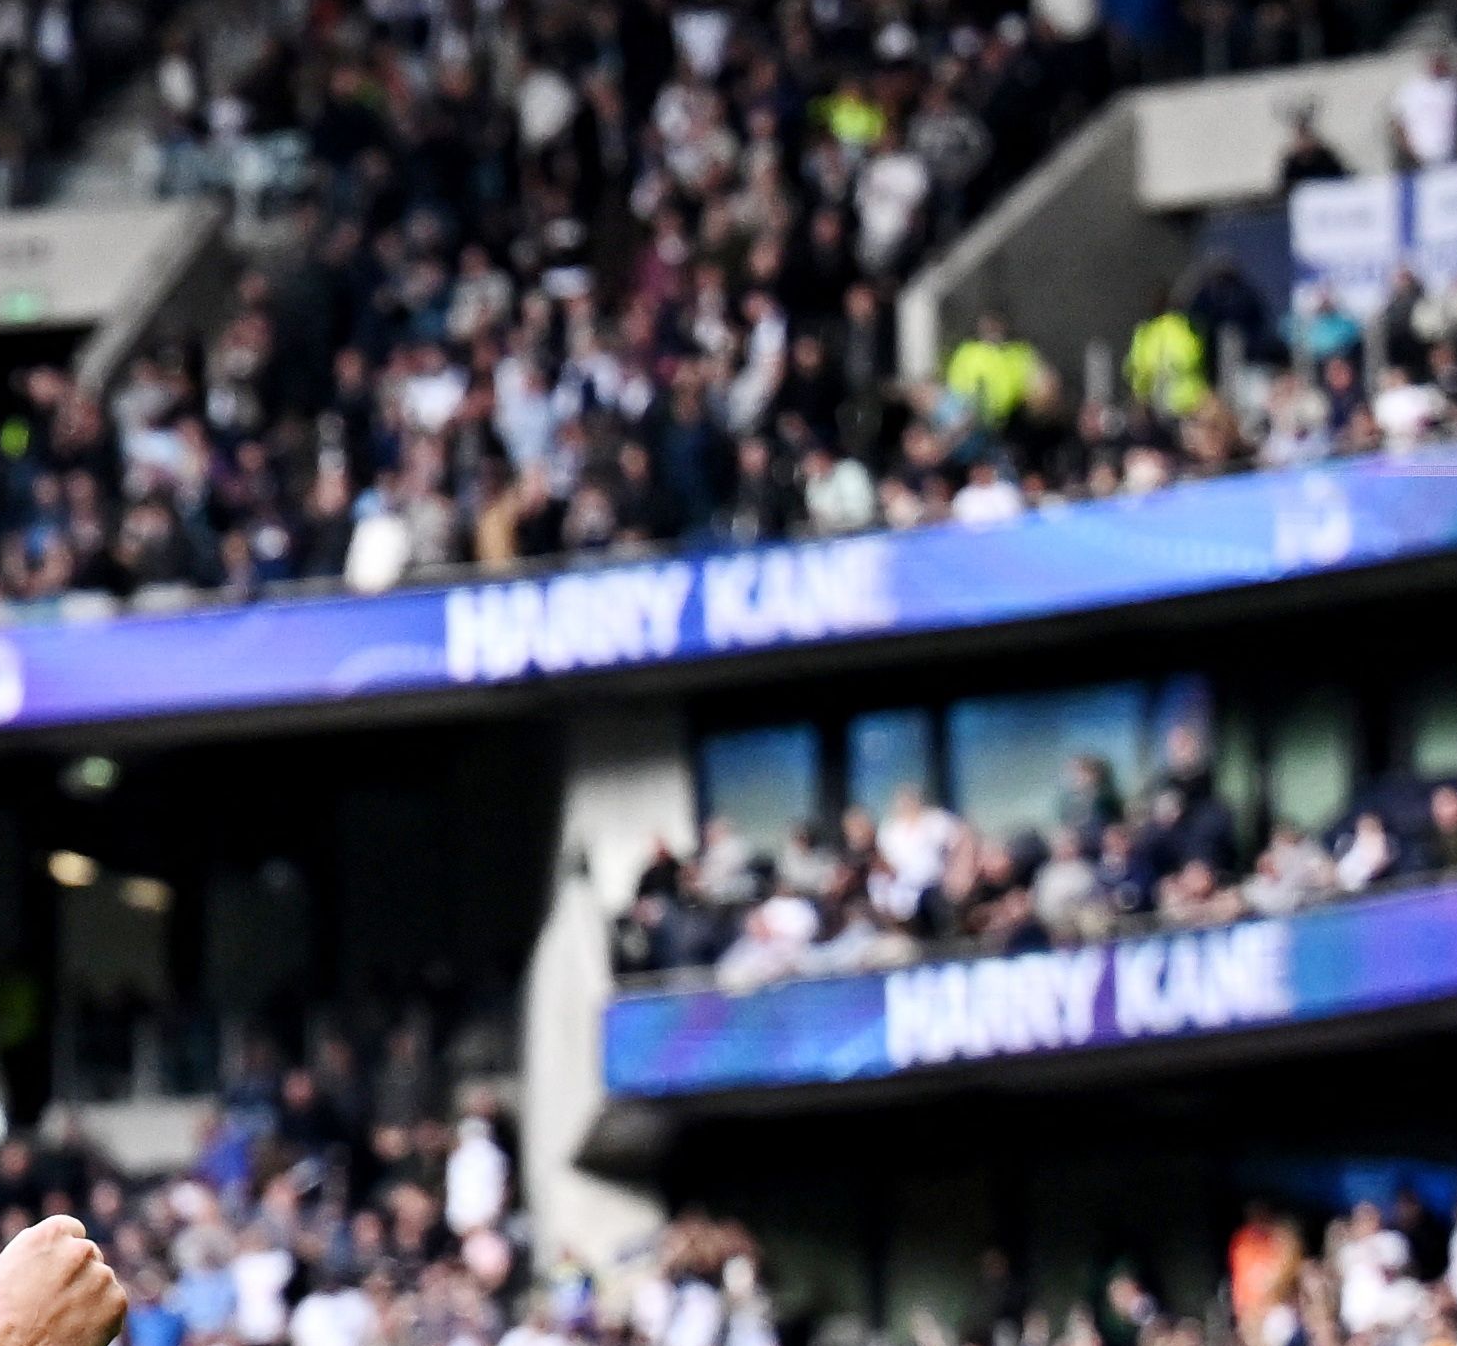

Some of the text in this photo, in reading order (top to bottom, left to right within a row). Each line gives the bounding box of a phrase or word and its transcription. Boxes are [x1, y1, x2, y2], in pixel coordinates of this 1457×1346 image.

[446, 535, 899, 682] HARRY KANE
[885, 919, 1288, 1067] HARRY KANE
